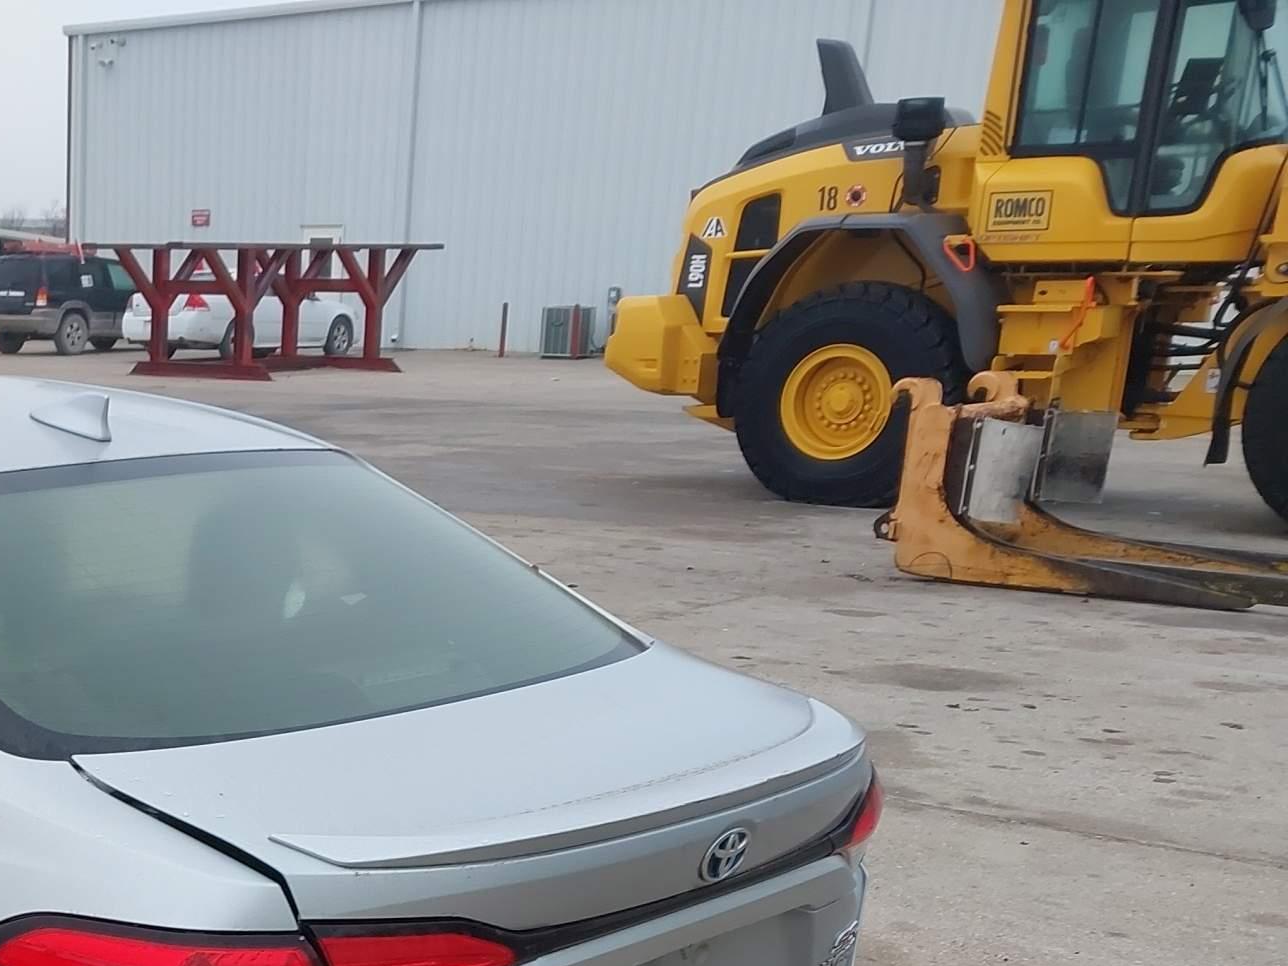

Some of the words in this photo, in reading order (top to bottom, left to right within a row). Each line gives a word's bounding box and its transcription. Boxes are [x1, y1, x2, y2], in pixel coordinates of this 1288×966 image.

[853, 140, 905, 156] VOL
[817, 185, 838, 211] 18
[993, 197, 1046, 218] ROMCO
[687, 253, 708, 289] L90H
